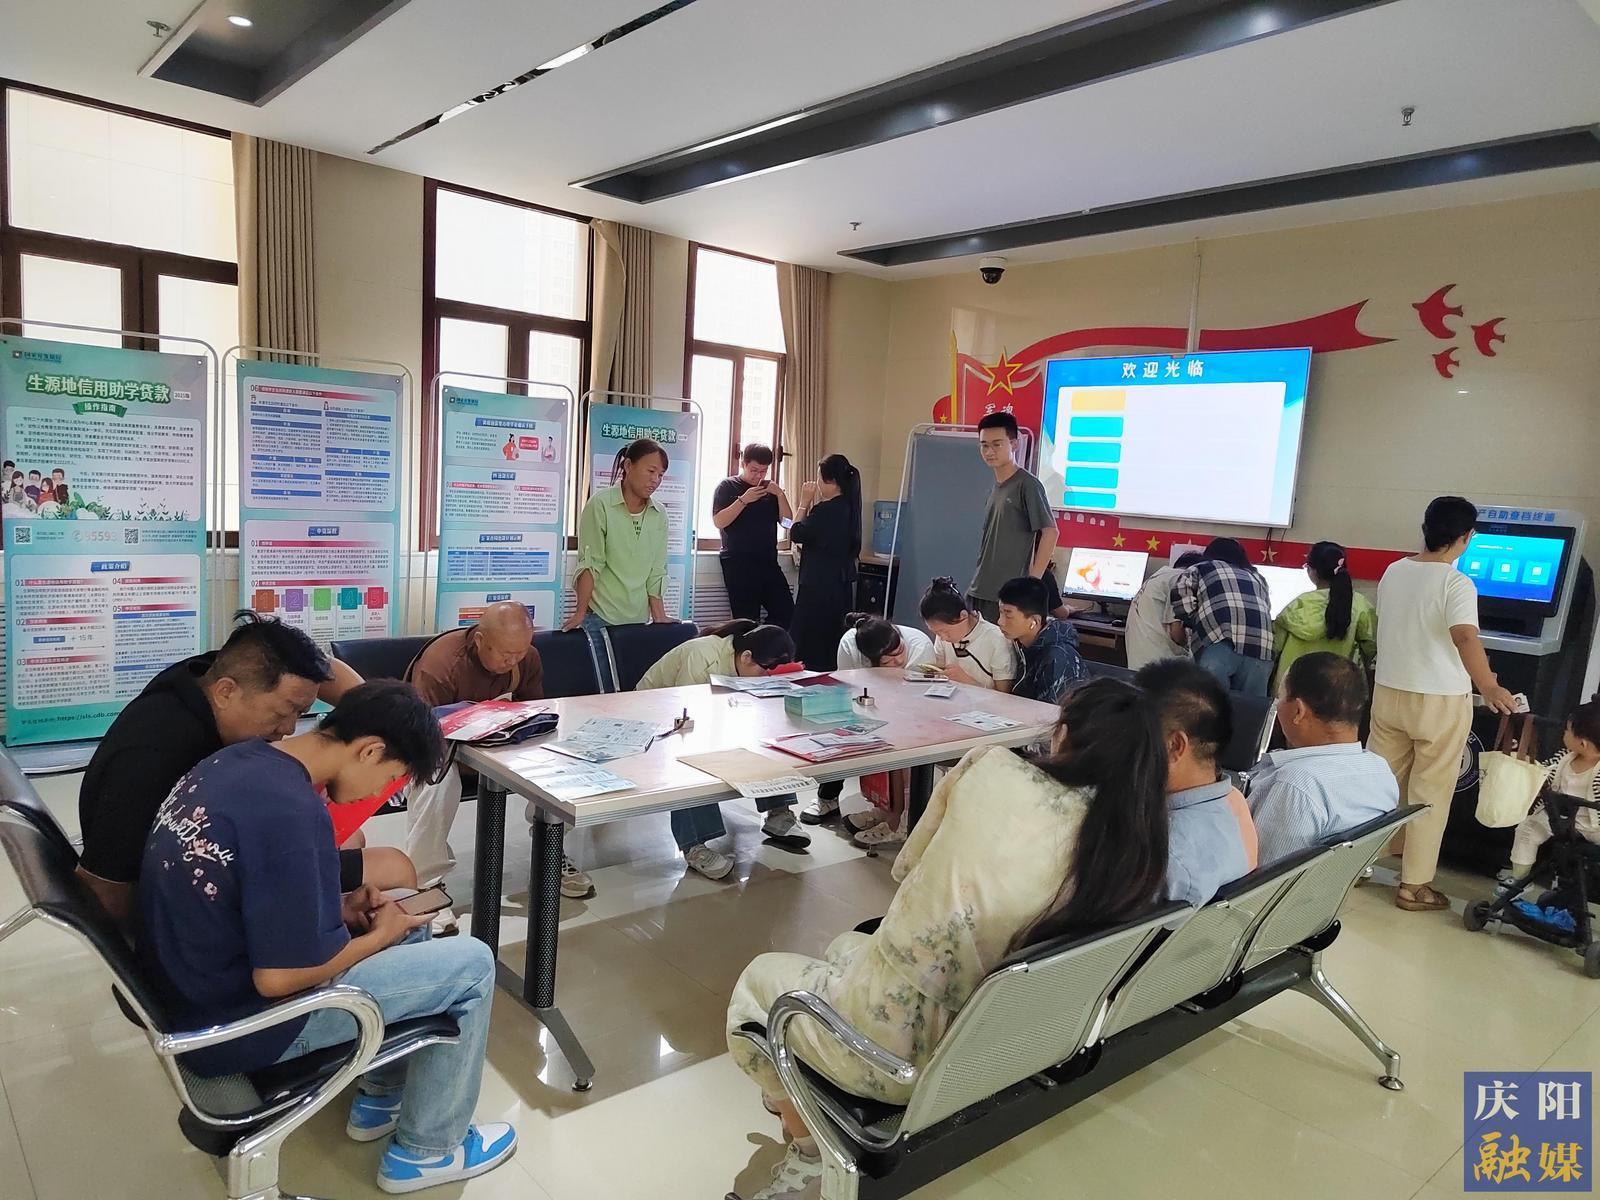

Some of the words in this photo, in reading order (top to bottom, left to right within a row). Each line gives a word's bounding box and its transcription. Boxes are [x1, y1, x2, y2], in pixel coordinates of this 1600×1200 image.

[1121, 359, 1204, 379] 欢迎光临
[27, 374, 171, 402] 生源地信用助学贷款
[84, 402, 117, 413] 操作指南
[602, 424, 677, 443] 生源地信用助学贷款
